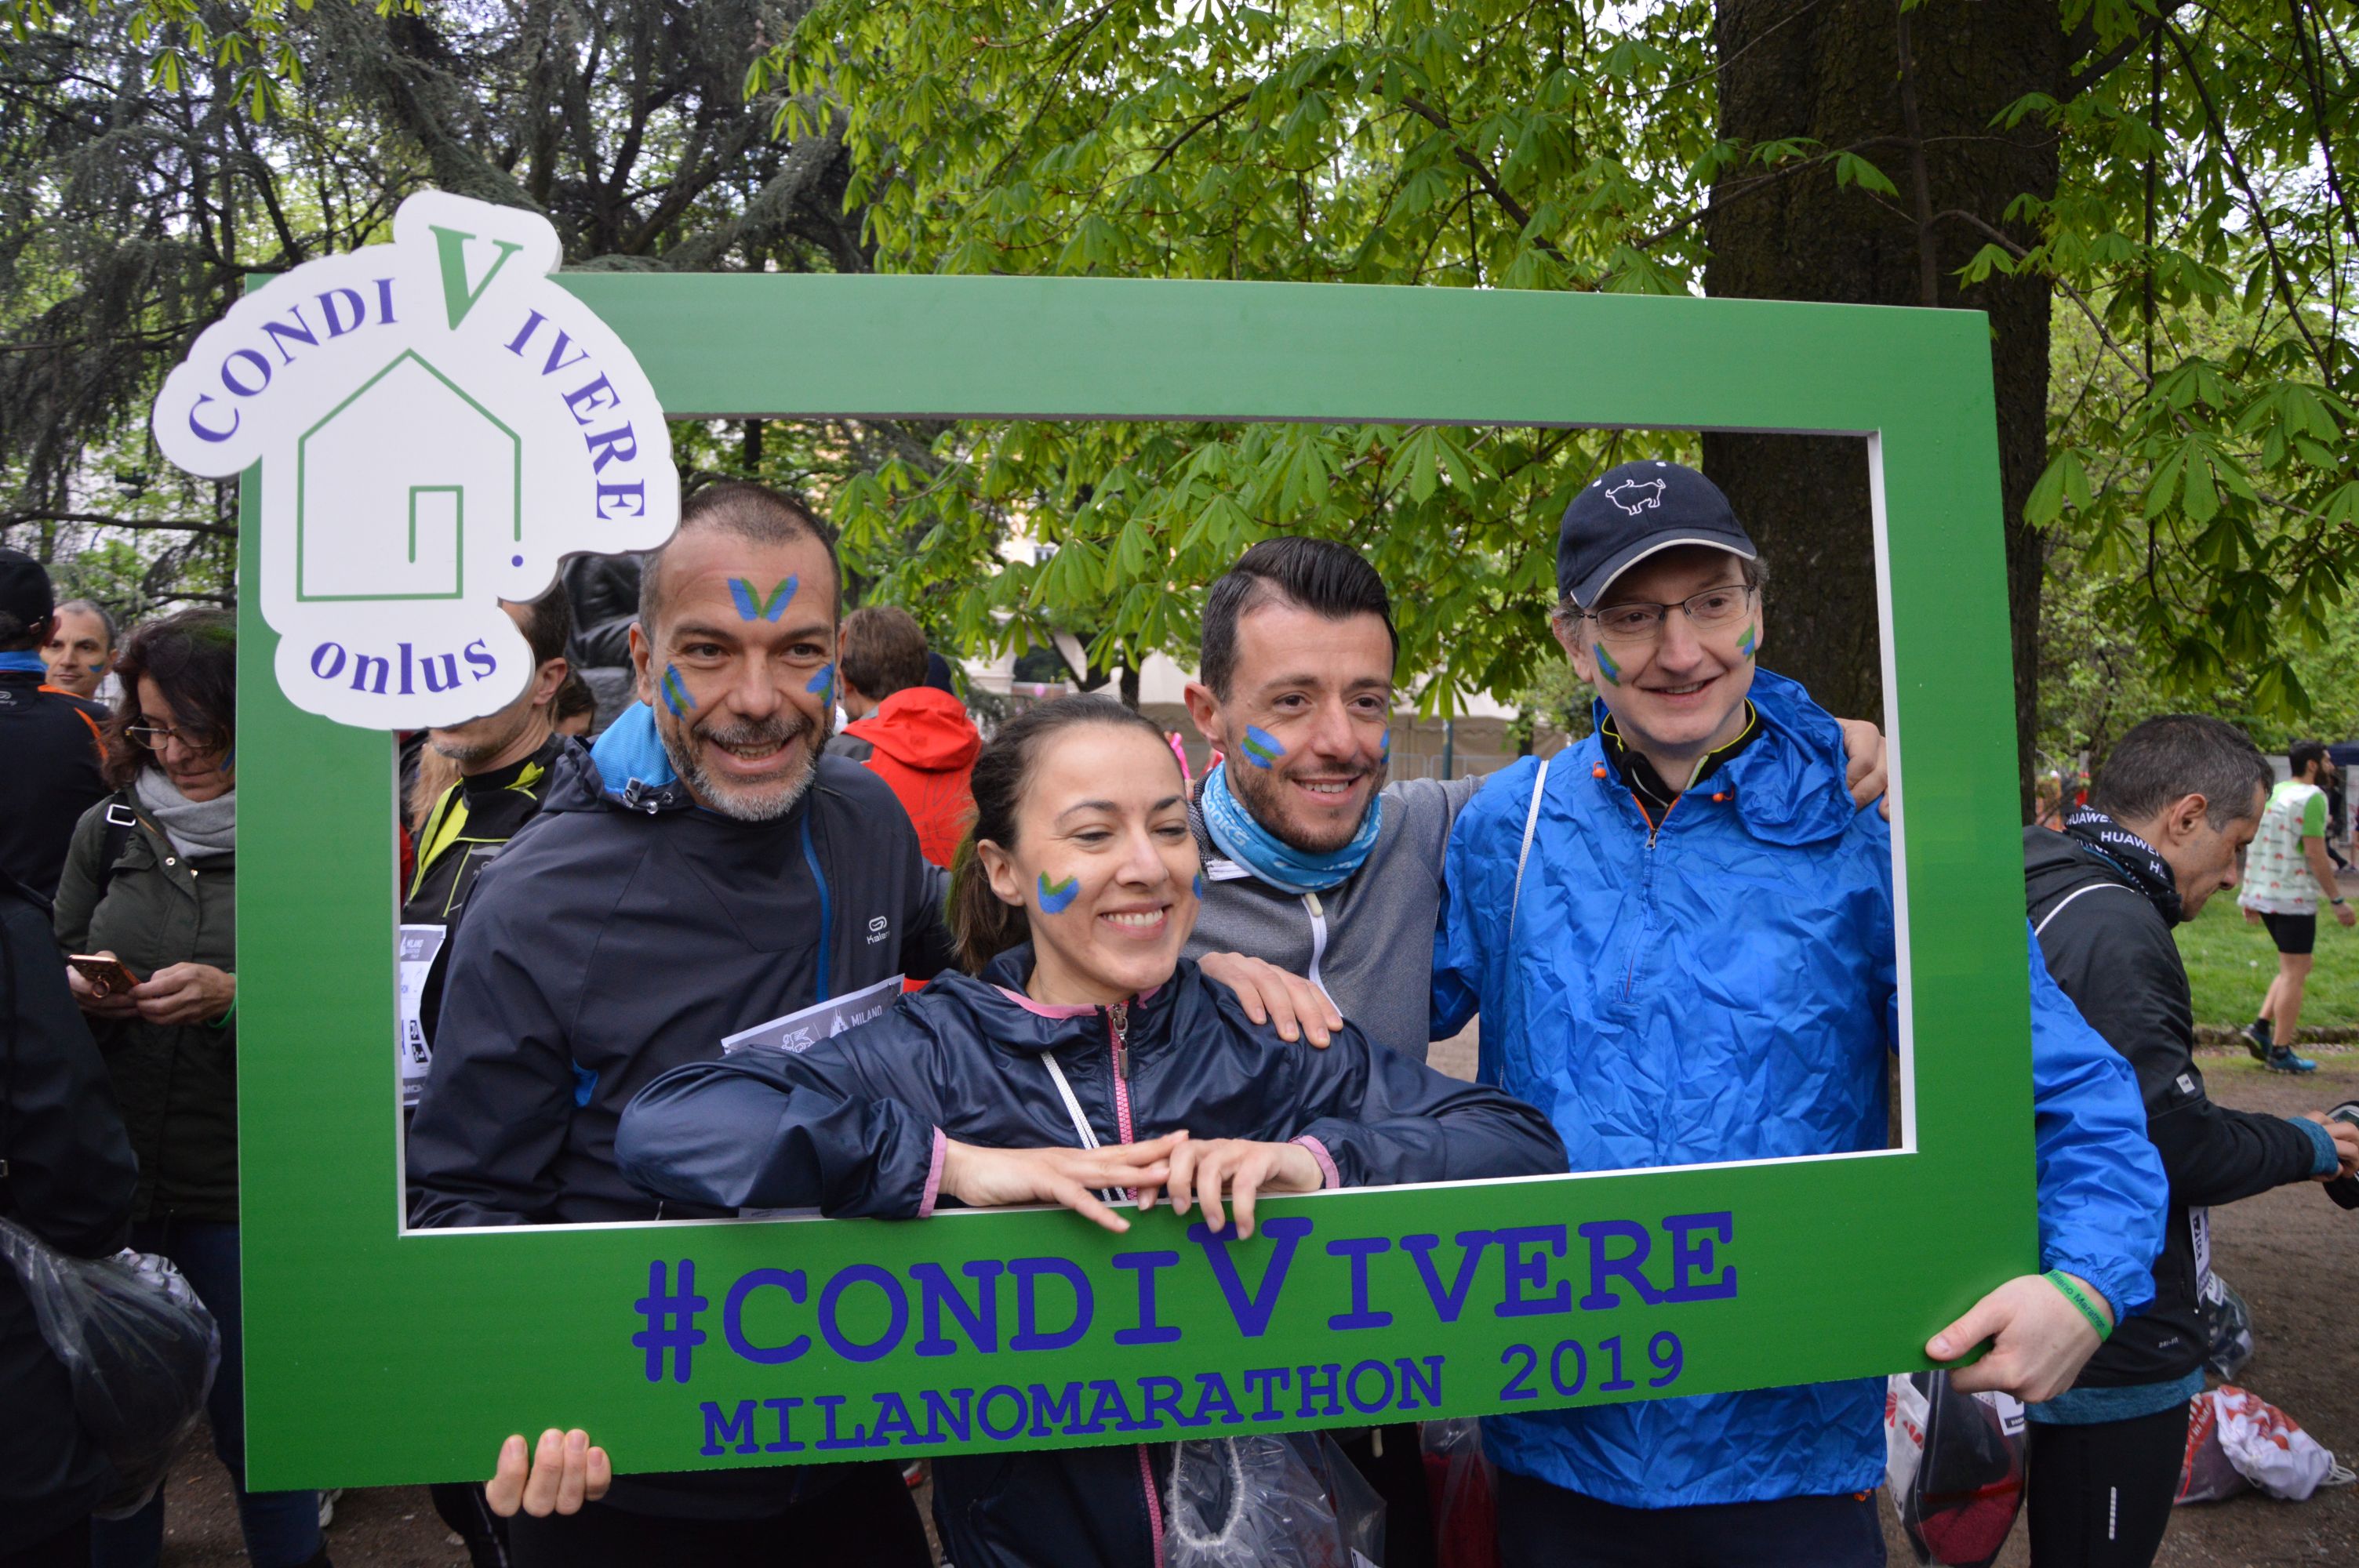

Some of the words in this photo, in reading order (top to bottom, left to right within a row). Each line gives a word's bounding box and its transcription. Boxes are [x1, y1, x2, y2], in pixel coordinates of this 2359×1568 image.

[851, 1004, 882, 1027] MILANO
[632, 1210, 1738, 1383] #CONDIVIVERE
[700, 1355, 1445, 1457] MILANOMARATHON
[1499, 1330, 1684, 1402] 2019
